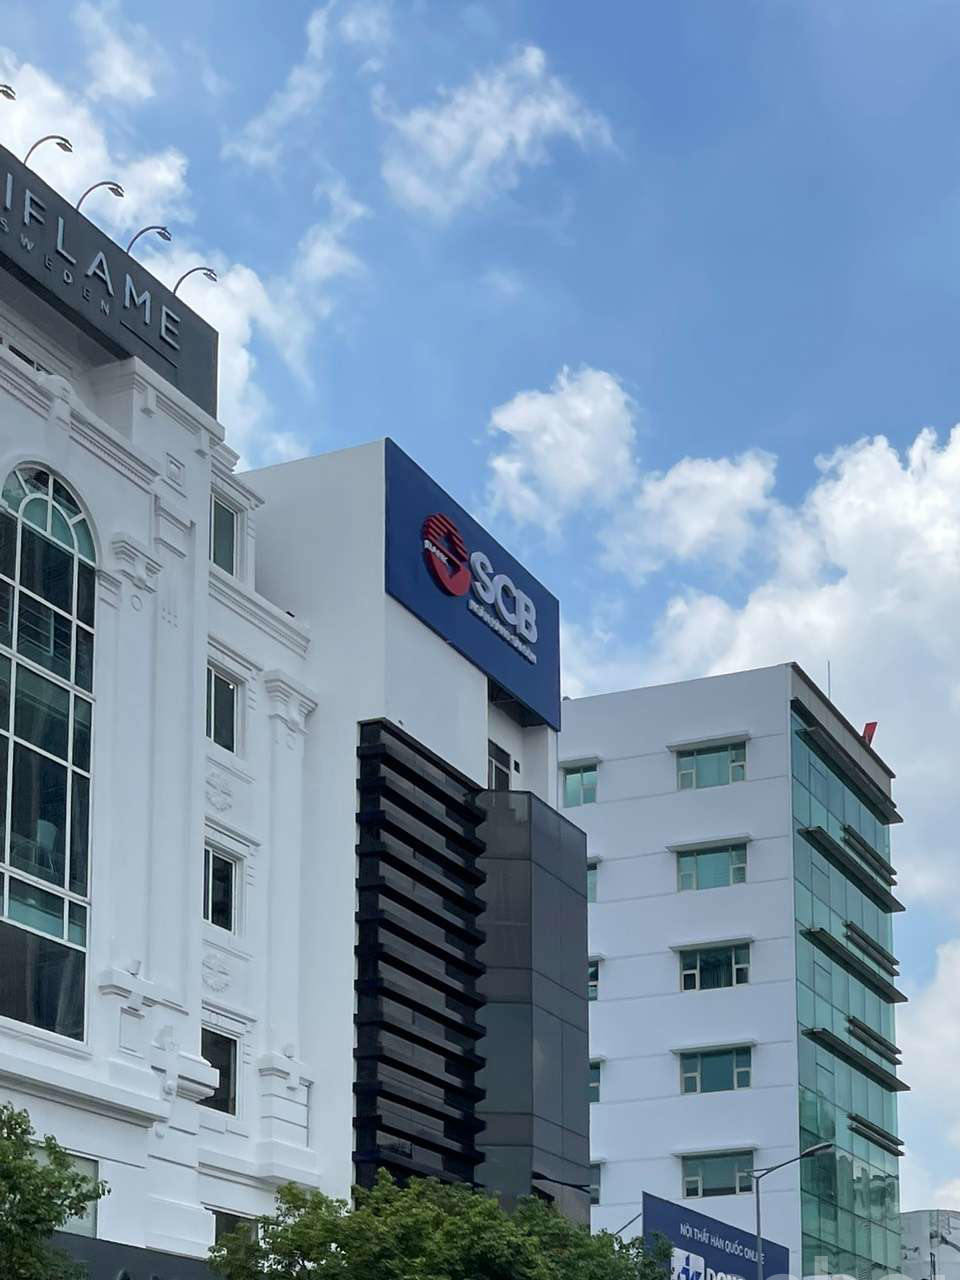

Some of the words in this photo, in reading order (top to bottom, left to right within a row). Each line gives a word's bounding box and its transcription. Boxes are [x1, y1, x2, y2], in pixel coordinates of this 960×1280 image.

[0, 217, 110, 317] SWEDEN
[470, 551, 538, 644] SCB
[724, 1240, 743, 1256] QUỐC
[744, 1247, 766, 1264] ONLIE
